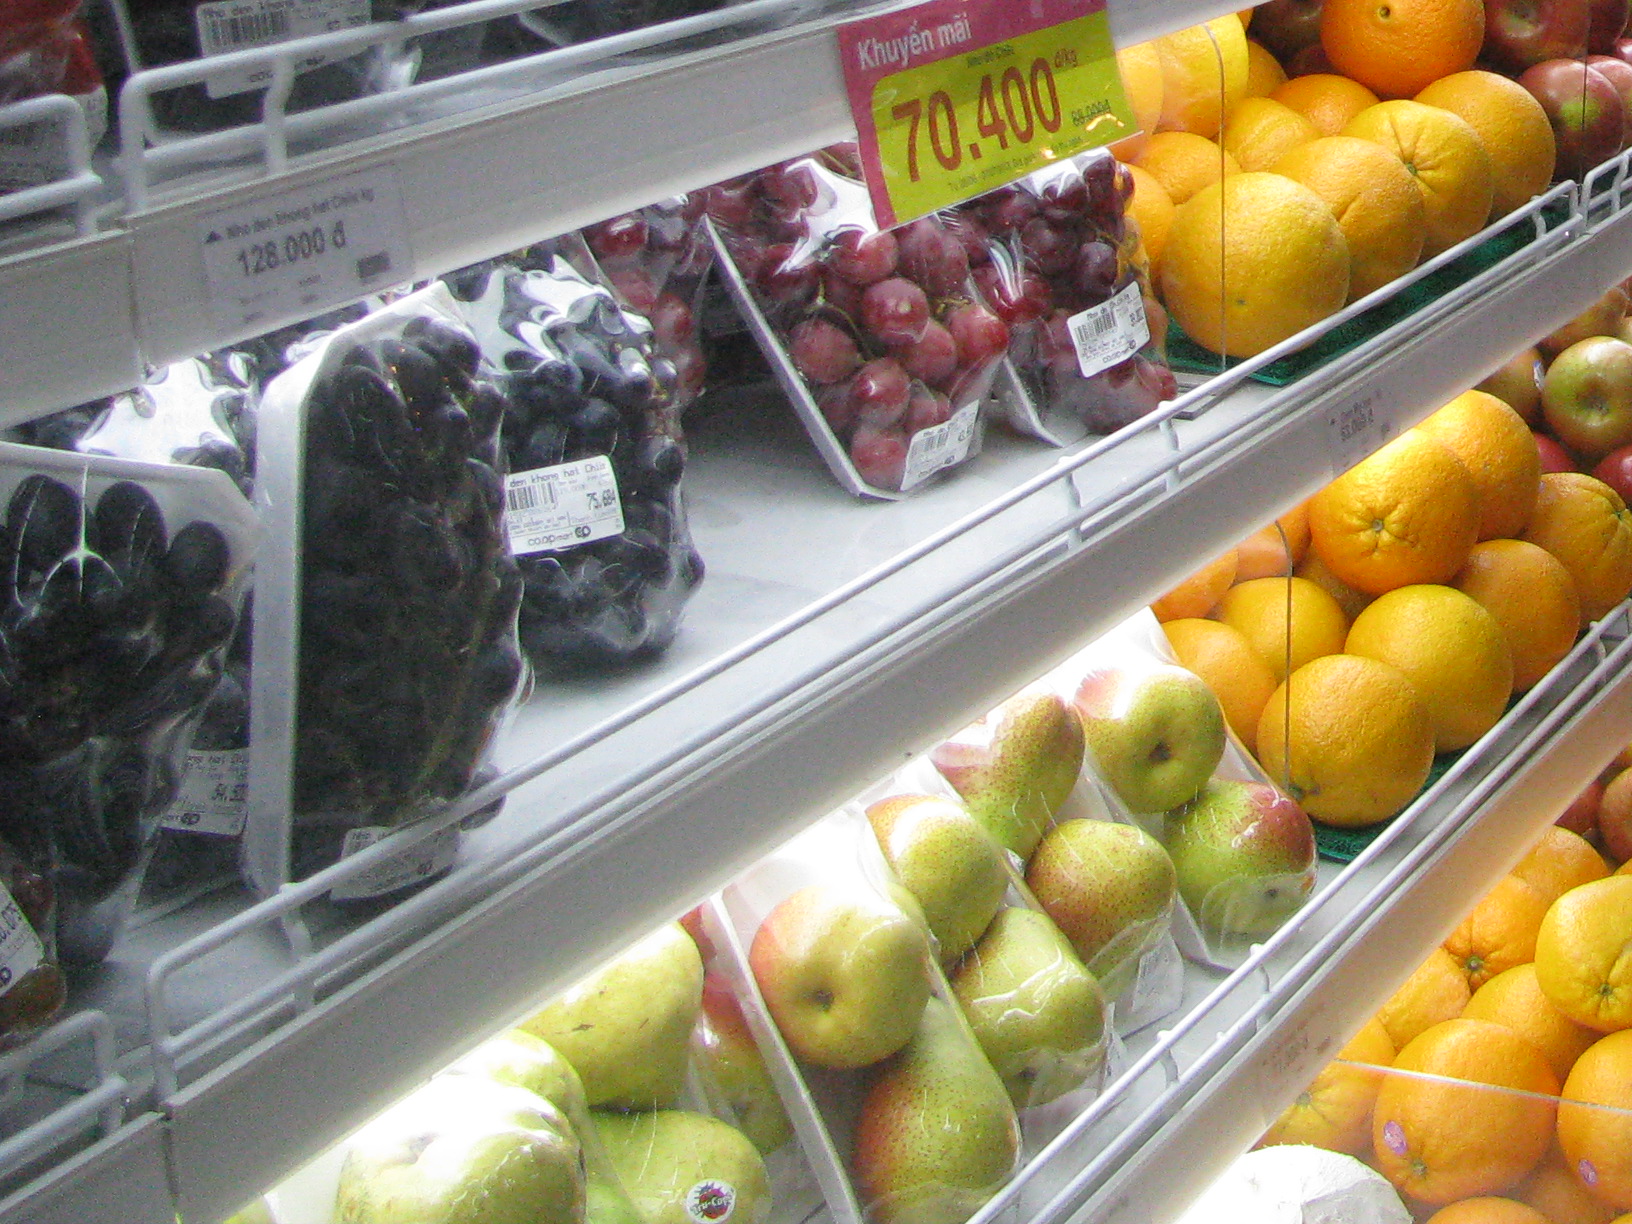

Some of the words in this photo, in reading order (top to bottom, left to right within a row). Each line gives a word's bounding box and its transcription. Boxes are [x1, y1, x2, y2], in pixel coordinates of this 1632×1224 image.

[858, 20, 935, 70] Khuyến
[891, 57, 1062, 182] 70.400
[238, 226, 326, 276] 128.000
